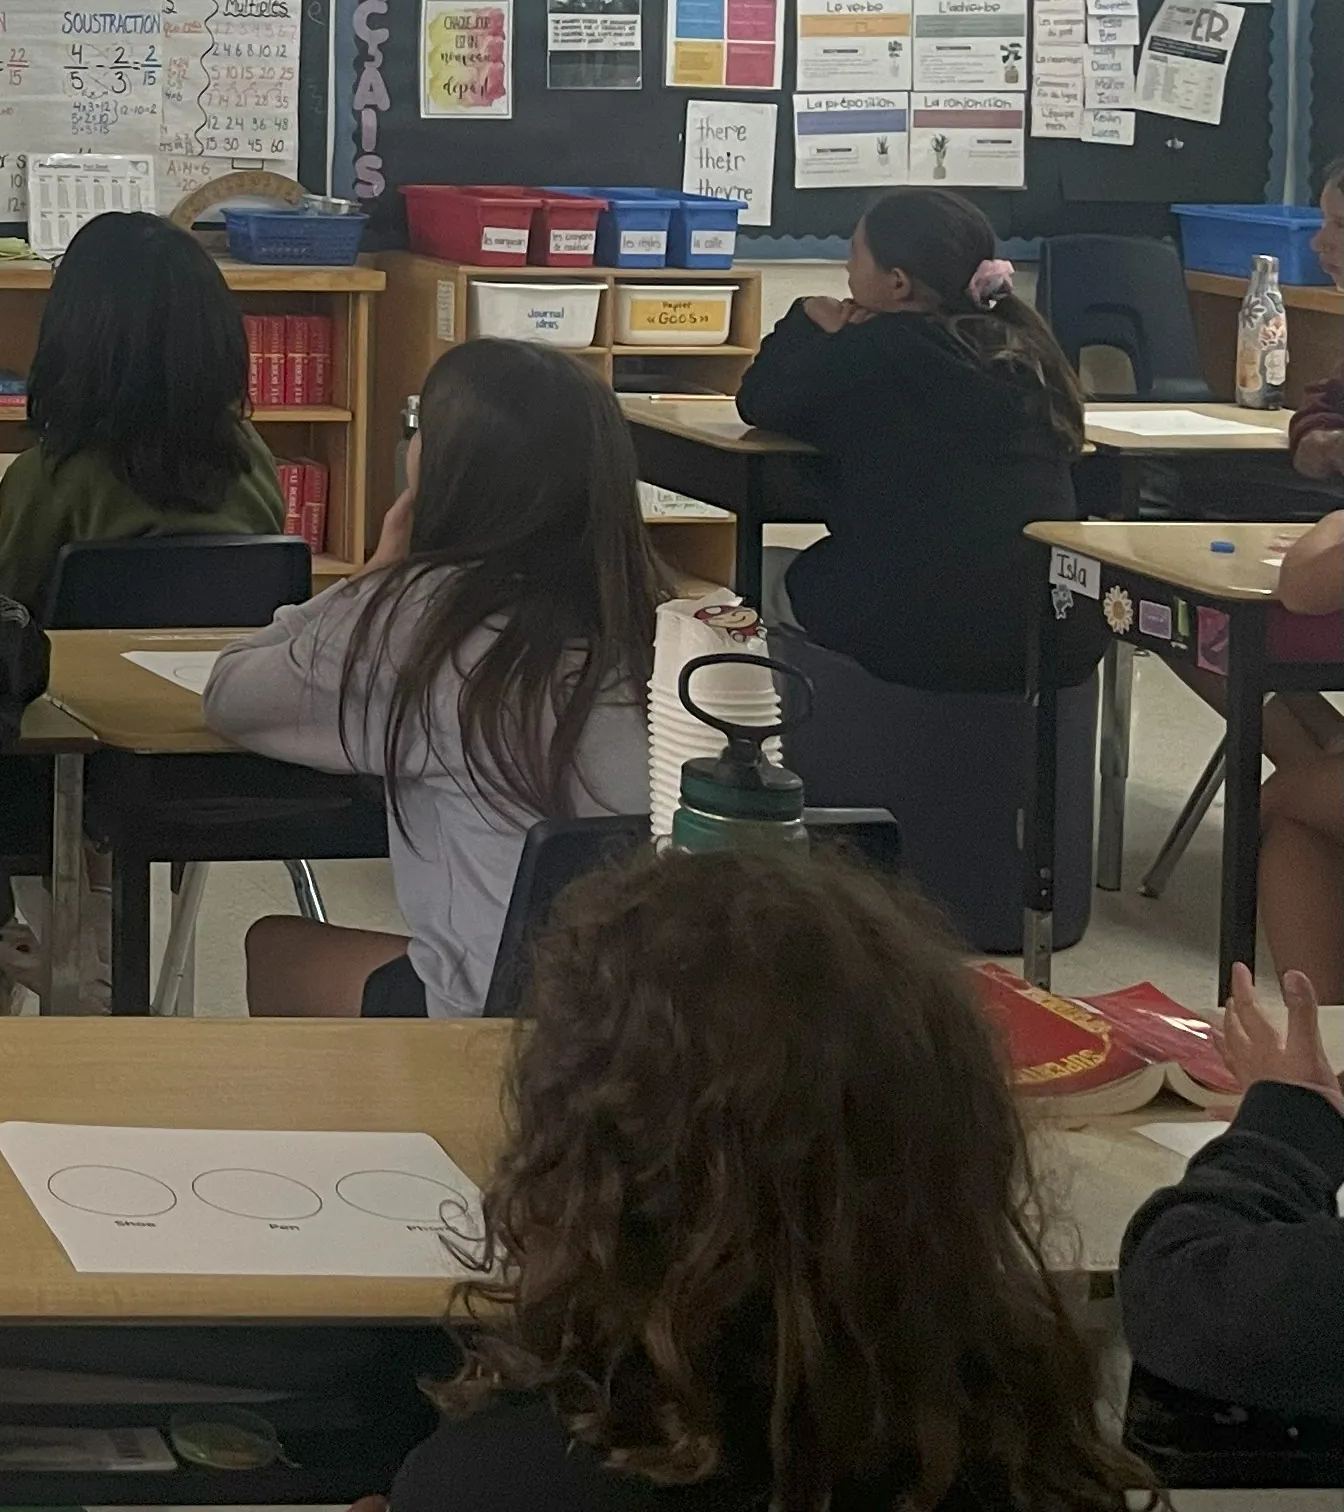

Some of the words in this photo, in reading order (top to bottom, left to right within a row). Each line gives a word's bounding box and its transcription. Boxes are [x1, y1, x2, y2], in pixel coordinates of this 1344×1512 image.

[847, 0, 884, 13] verbe
[938, 0, 1001, 14] L'adverbe
[62, 11, 161, 34] SOUSTRACTION
[1191, 7, 1230, 43] ER
[697, 114, 747, 142] there
[697, 144, 746, 171] their
[527, 306, 564, 320] Journal
[661, 300, 693, 311] Papier
[1056, 552, 1087, 588] Isla
[268, 1222, 301, 1232] Pen
